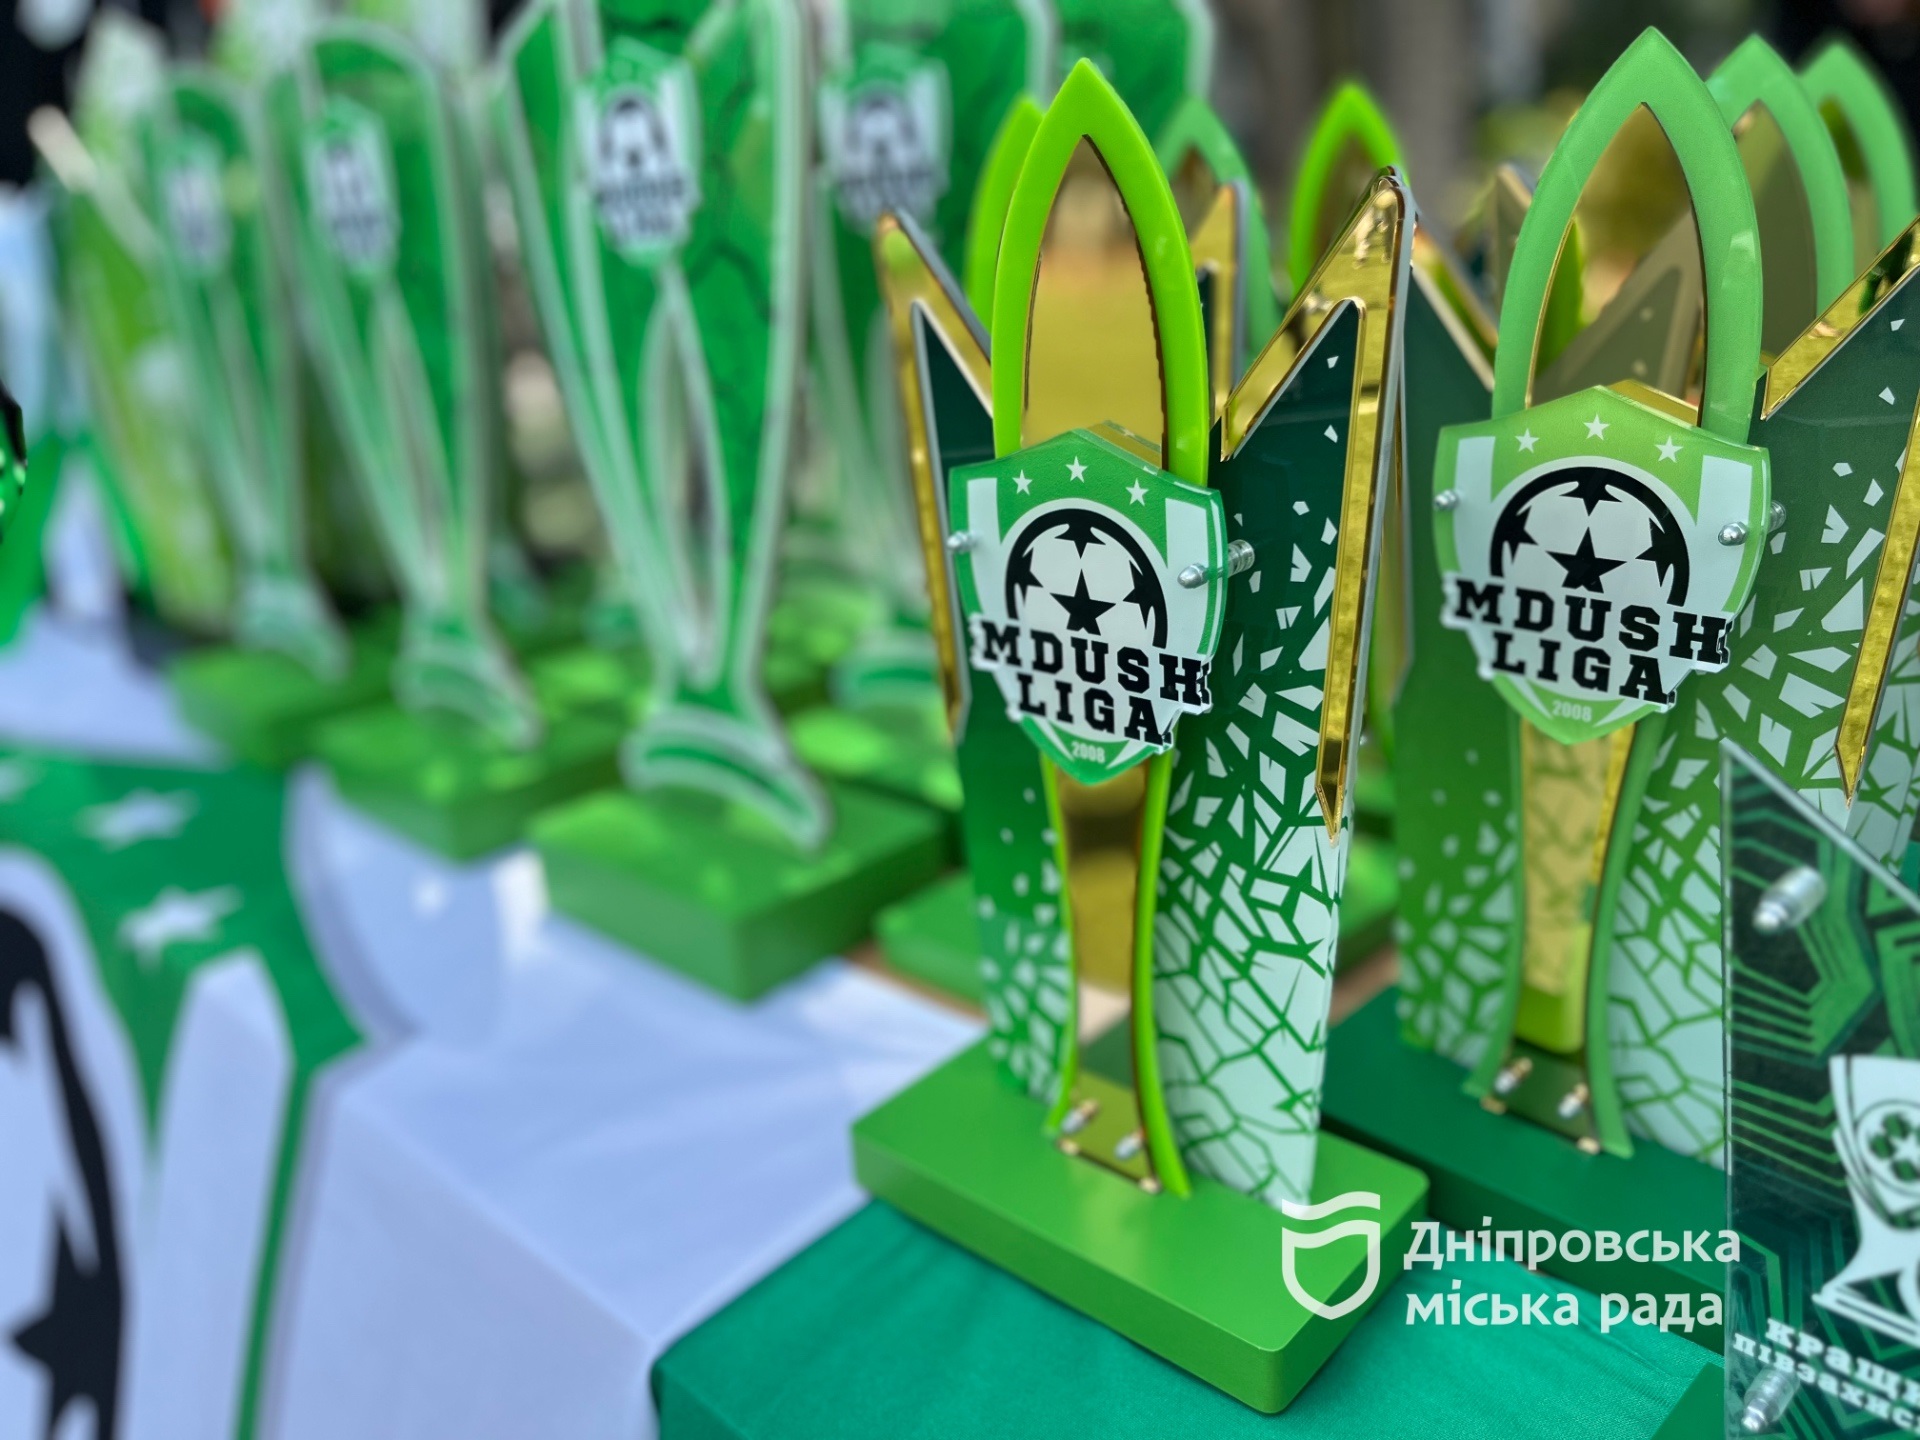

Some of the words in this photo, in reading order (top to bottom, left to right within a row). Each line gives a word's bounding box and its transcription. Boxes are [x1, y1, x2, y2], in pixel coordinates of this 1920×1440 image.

[1454, 579, 1728, 665] MDUSH
[980, 620, 1208, 705] MDUSH
[1492, 631, 1671, 705] LIGA
[1017, 674, 1170, 745] LIGA
[1553, 699, 1592, 722] 2008
